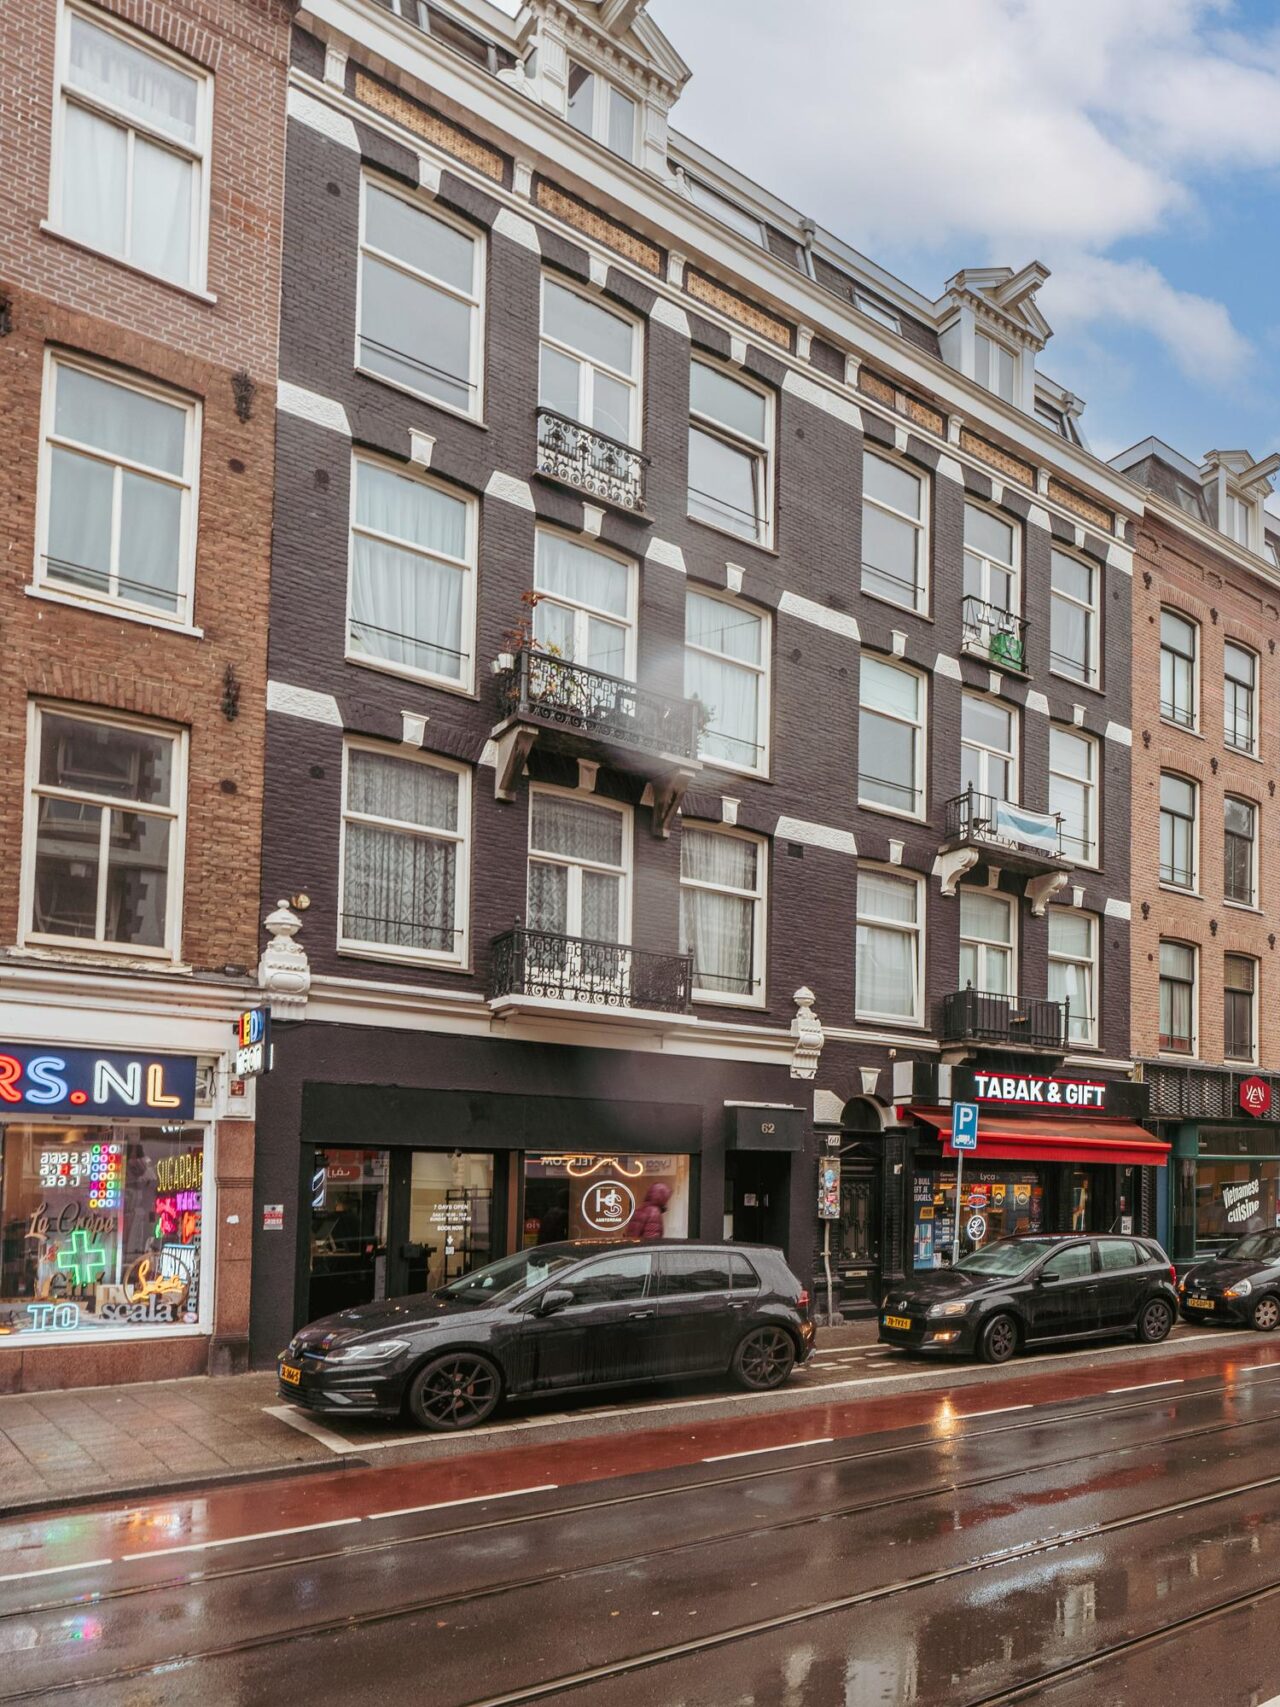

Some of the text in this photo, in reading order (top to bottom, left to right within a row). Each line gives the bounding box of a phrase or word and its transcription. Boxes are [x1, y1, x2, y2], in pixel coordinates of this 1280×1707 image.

[974, 1075, 1105, 1106] TABAK & GIFT
[761, 1123, 775, 1133] 62
[960, 1107, 973, 1130] P
[829, 1136, 840, 1146] 60
[1222, 1179, 1259, 1209] Vietnamese
[1227, 1199, 1260, 1223] cuisine
[27, 1302, 79, 1332] TO
